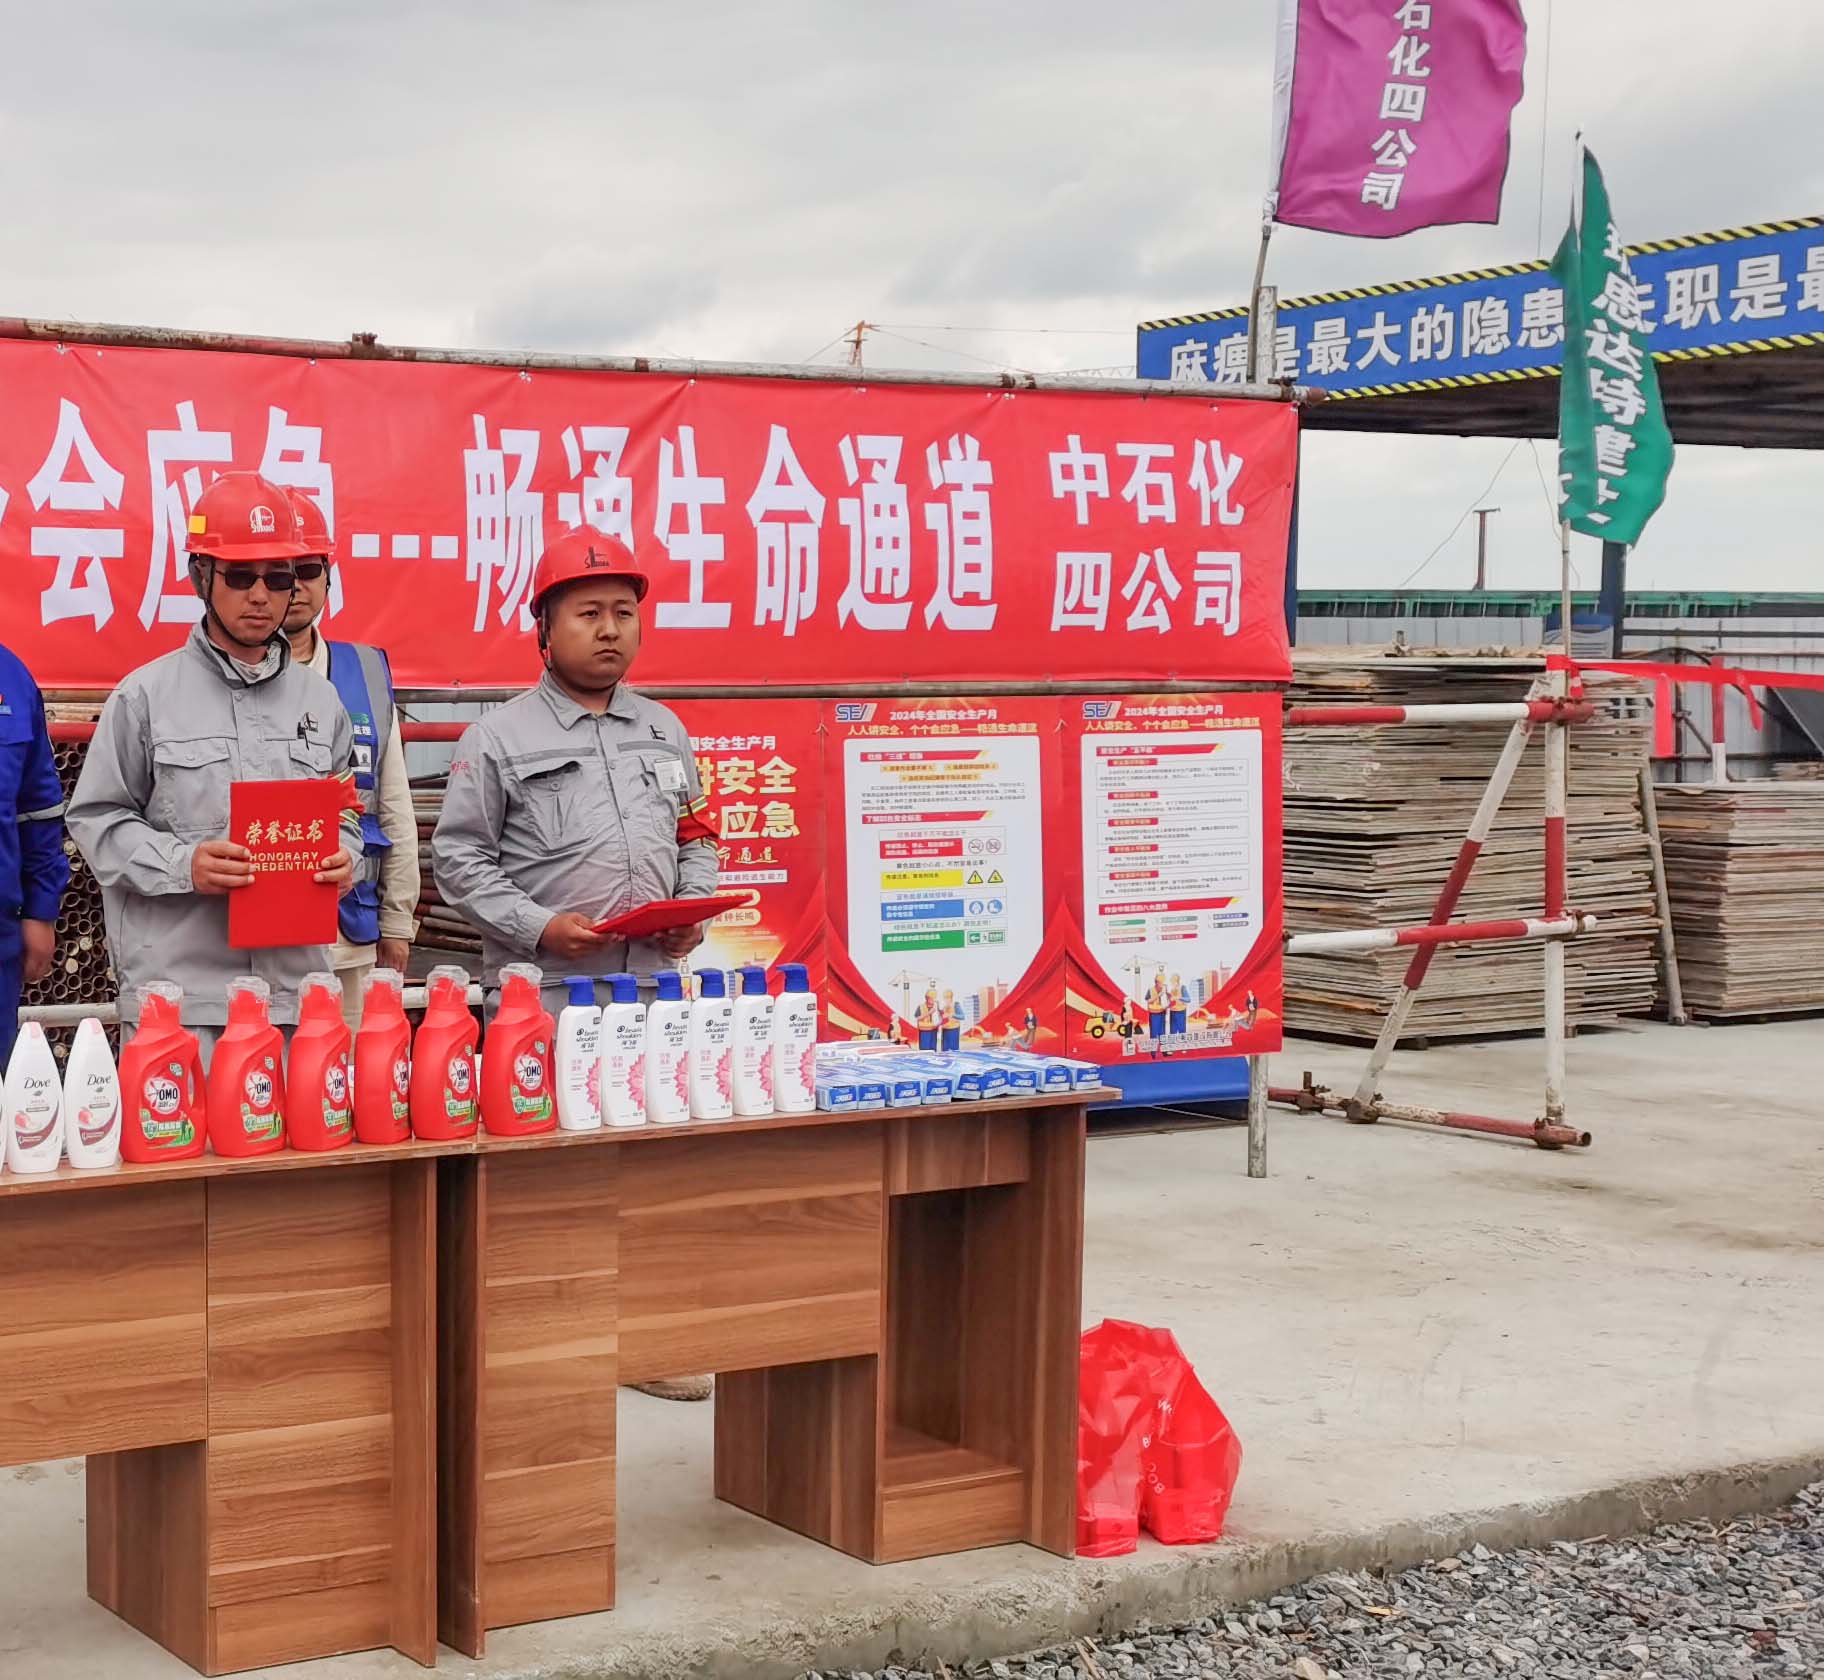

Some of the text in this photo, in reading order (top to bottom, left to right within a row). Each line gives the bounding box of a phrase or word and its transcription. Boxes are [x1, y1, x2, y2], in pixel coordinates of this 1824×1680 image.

[1050, 433, 1246, 528] 中石化
[1050, 547, 1243, 636] 四公司
[245, 819, 325, 845] 荣誉证书
[249, 851, 319, 861] HONORARY
[255, 861, 322, 872] REDENTIAL
[526, 1066, 542, 1078] OMO
[24, 1077, 52, 1089] Dove
[87, 1074, 111, 1086] Dove
[256, 1081, 271, 1095] OMO
[159, 1088, 178, 1101] OMO
